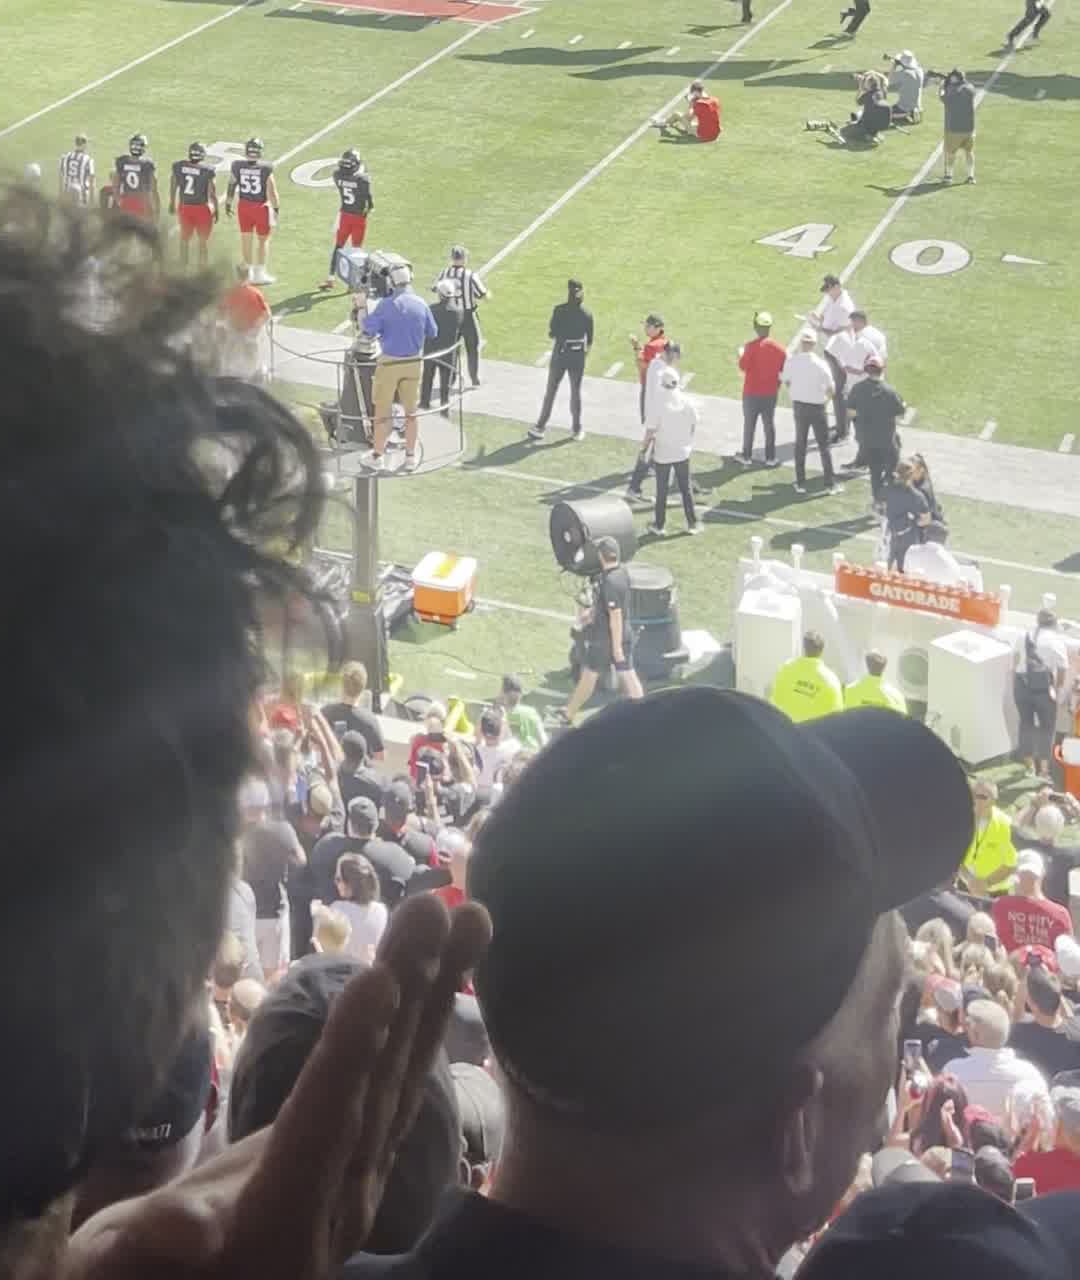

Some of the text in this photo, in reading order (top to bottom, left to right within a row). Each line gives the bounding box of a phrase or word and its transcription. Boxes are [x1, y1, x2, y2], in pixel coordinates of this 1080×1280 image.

[183, 175, 195, 195] 2
[239, 174, 262, 195] 53
[343, 187, 355, 205] 5
[869, 582, 961, 614] GATORADE
